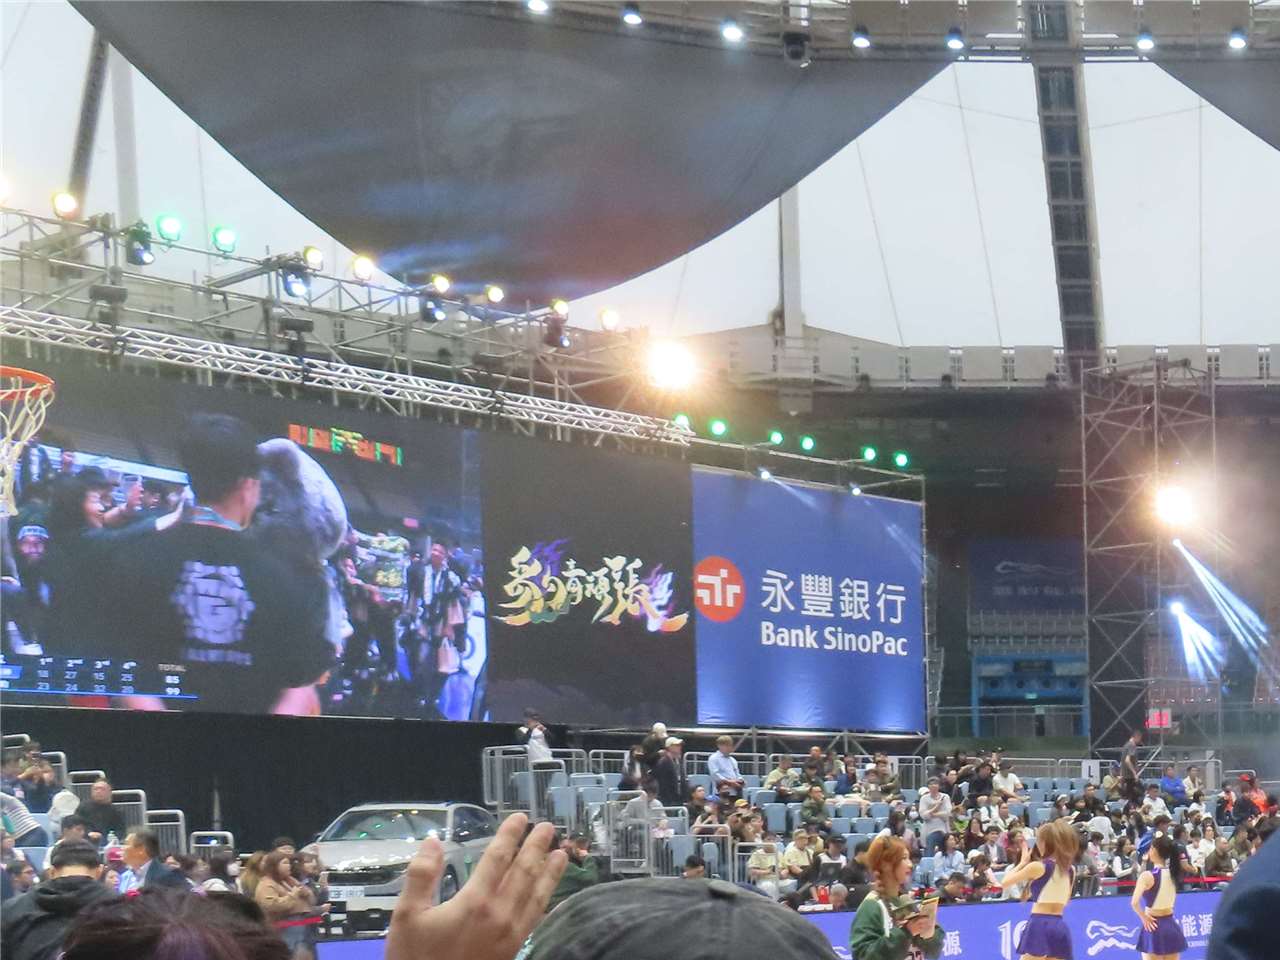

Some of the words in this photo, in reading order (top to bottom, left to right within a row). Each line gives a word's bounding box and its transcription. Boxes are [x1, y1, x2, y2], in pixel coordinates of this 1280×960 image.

[761, 569, 906, 624] 永豐銀行
[761, 621, 819, 649] Bank
[823, 625, 908, 656] SinoPac
